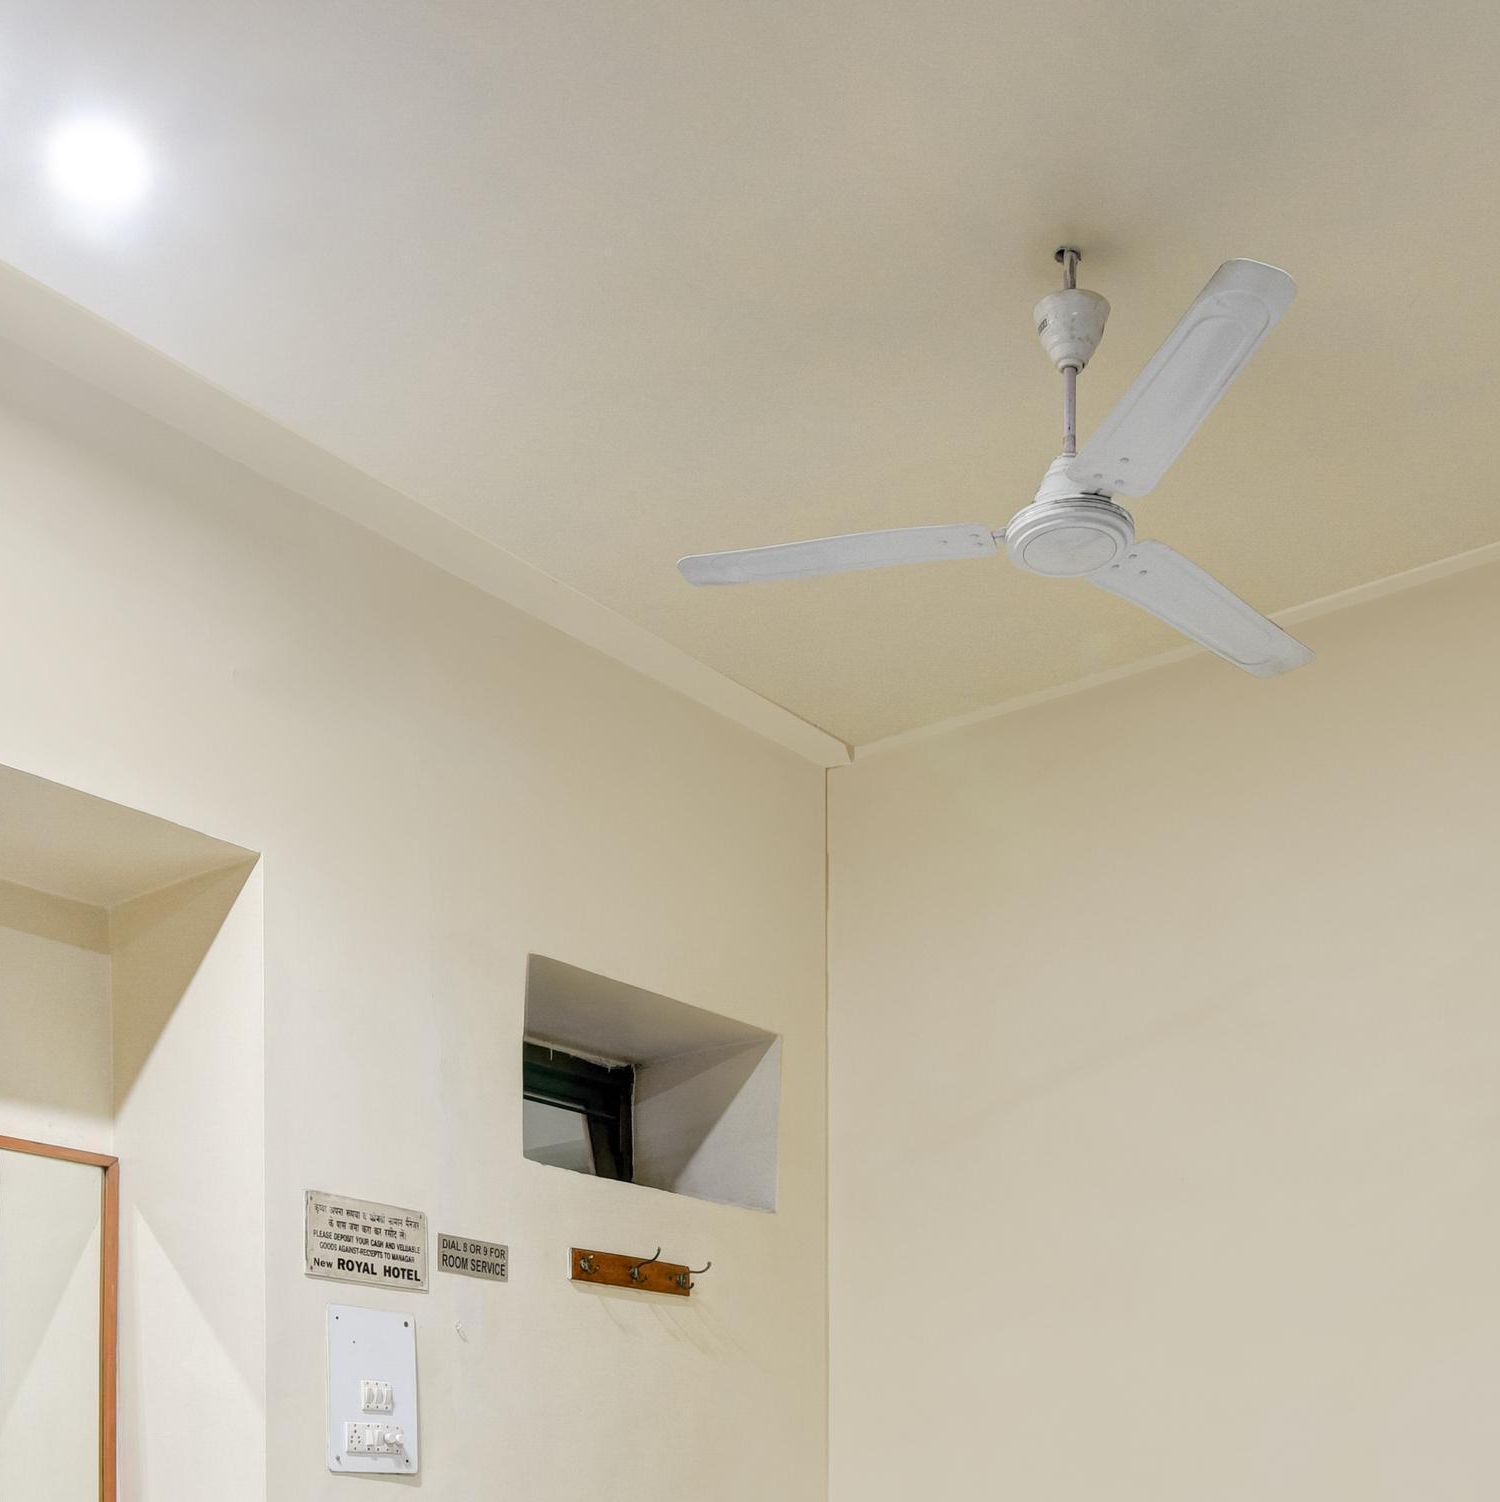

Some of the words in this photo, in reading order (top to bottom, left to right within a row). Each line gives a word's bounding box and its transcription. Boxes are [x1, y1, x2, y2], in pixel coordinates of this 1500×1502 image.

[313, 1229, 332, 1240] PLEASE
[333, 1232, 354, 1243] DEPOSIT
[355, 1236, 370, 1246] YOUR
[370, 1239, 384, 1248] CASH
[385, 1241, 396, 1250] AND
[319, 1241, 338, 1252] GOODS
[384, 1251, 391, 1260] TO
[442, 1238, 461, 1251] DIAL
[463, 1242, 468, 1253] 8
[469, 1243, 482, 1256] OR
[483, 1246, 488, 1257] 9
[489, 1247, 505, 1260] FOR
[313, 1257, 333, 1268] New
[337, 1258, 377, 1275] ROYAL
[383, 1265, 421, 1281] HOTEL
[442, 1253, 469, 1270] ROOM
[470, 1258, 505, 1276] SERVICE
